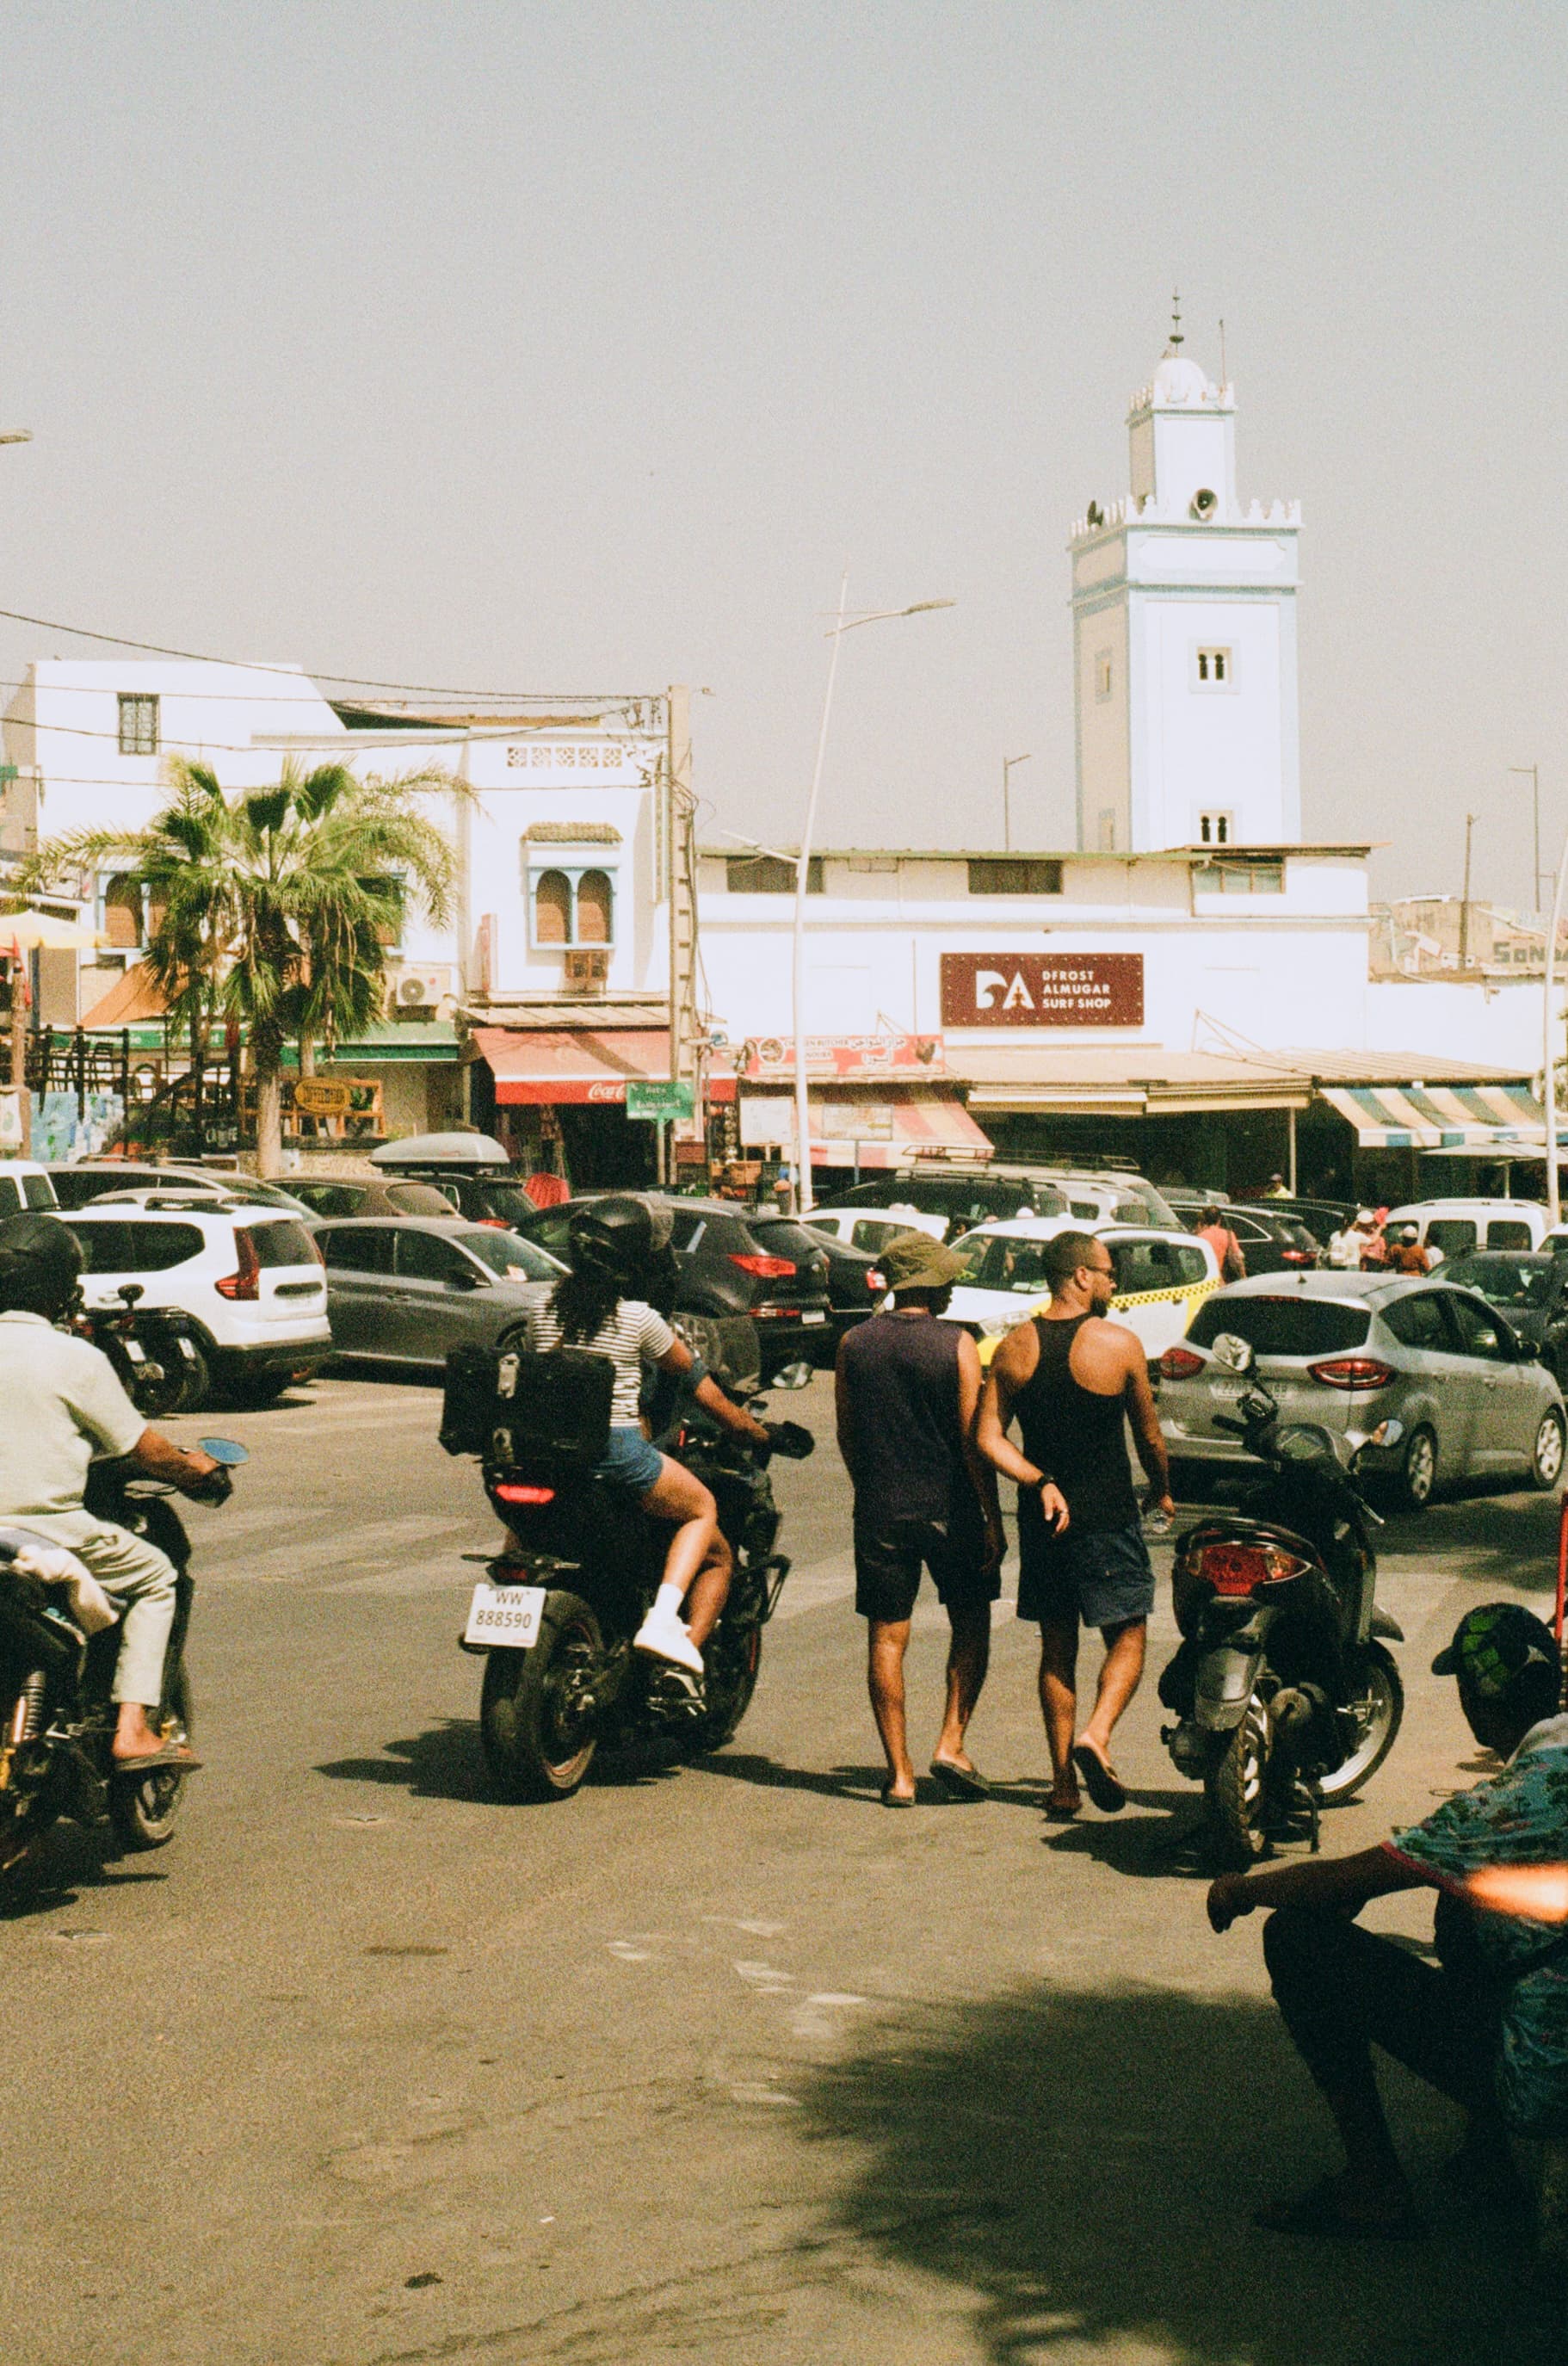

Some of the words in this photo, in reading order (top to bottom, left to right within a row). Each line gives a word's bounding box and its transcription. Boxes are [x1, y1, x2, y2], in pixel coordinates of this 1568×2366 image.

[1042, 970, 1094, 981] DFROST
[1043, 984, 1110, 995] ALMUGAR
[1042, 998, 1075, 1010] SURF
[1077, 998, 1112, 1010] SHOP
[496, 1591, 524, 1605] WW
[475, 1609, 533, 1629] 888590
